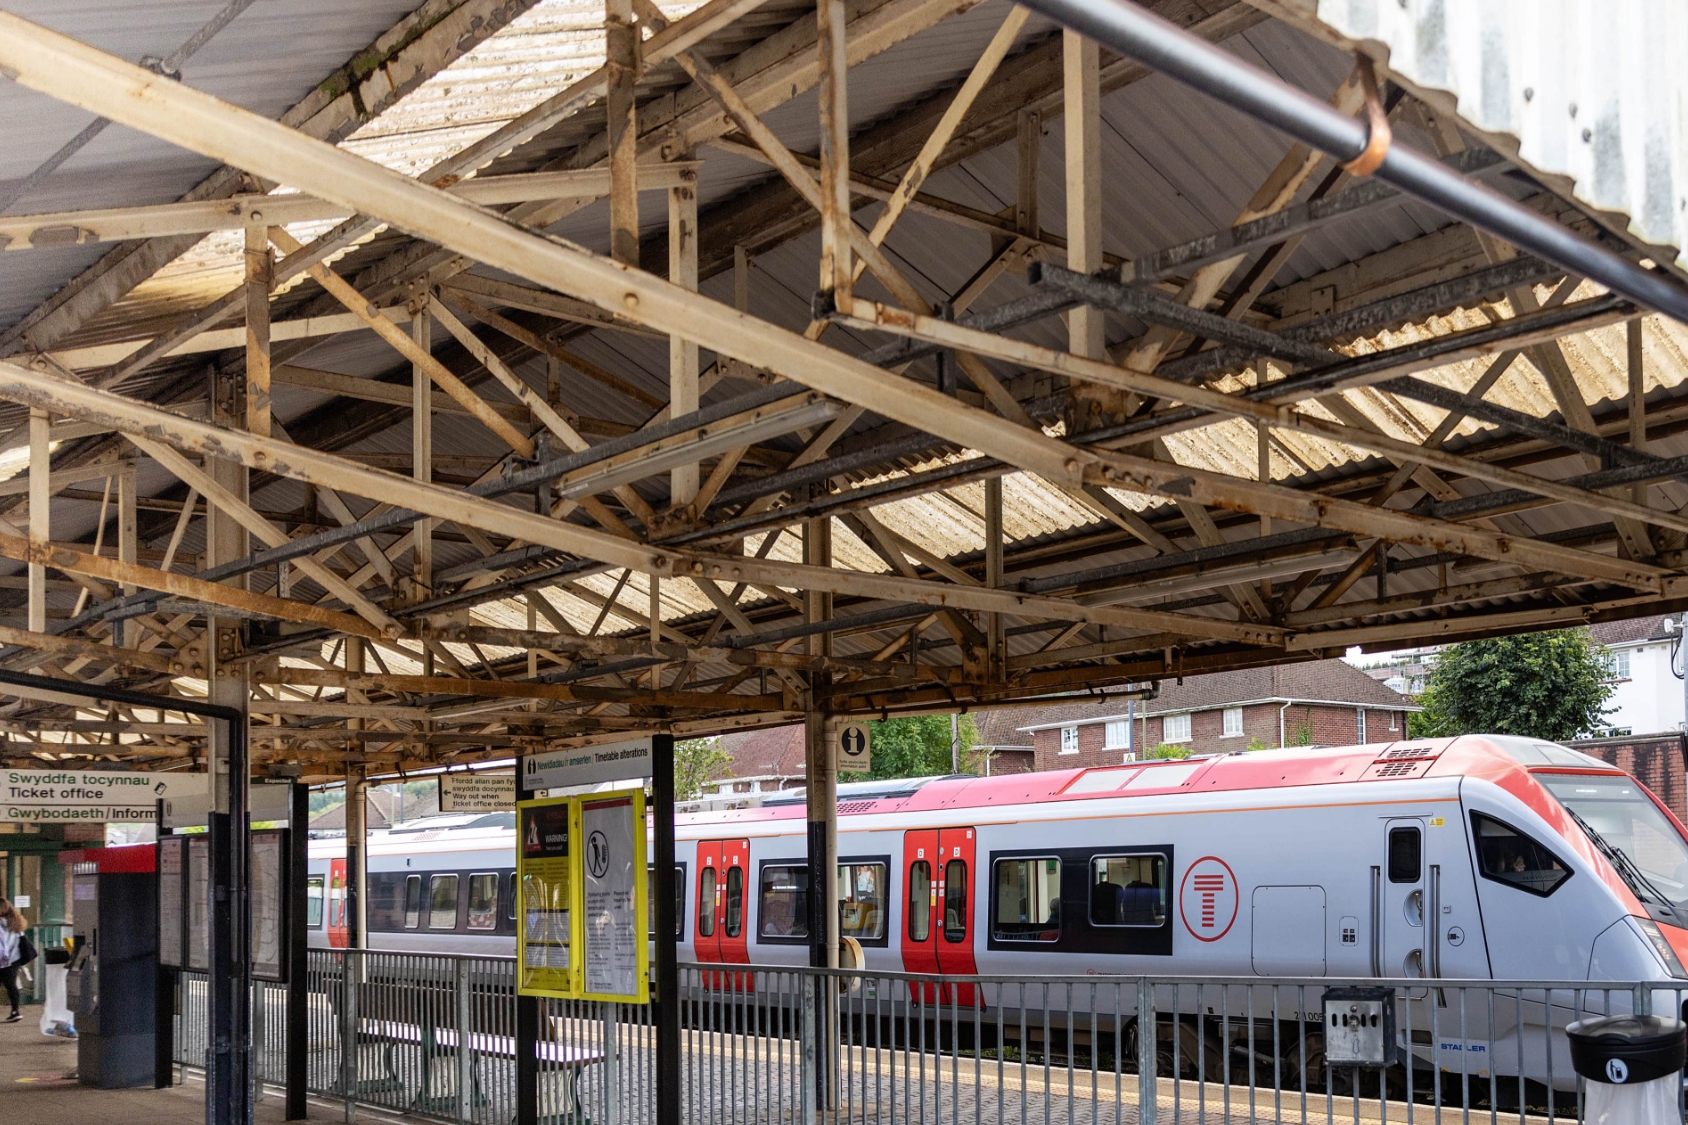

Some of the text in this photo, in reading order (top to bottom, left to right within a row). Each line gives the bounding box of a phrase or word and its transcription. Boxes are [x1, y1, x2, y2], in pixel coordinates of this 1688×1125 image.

[595, 747, 648, 763] Timetable alterations
[537, 759, 564, 771] Newidiadau
[569, 755, 591, 766] amserlen
[8, 772, 150, 787] Swyddfa tocynnau
[492, 778, 505, 786] pan
[8, 787, 104, 799] Ticket office
[452, 785, 515, 793] swyddfa docynnau
